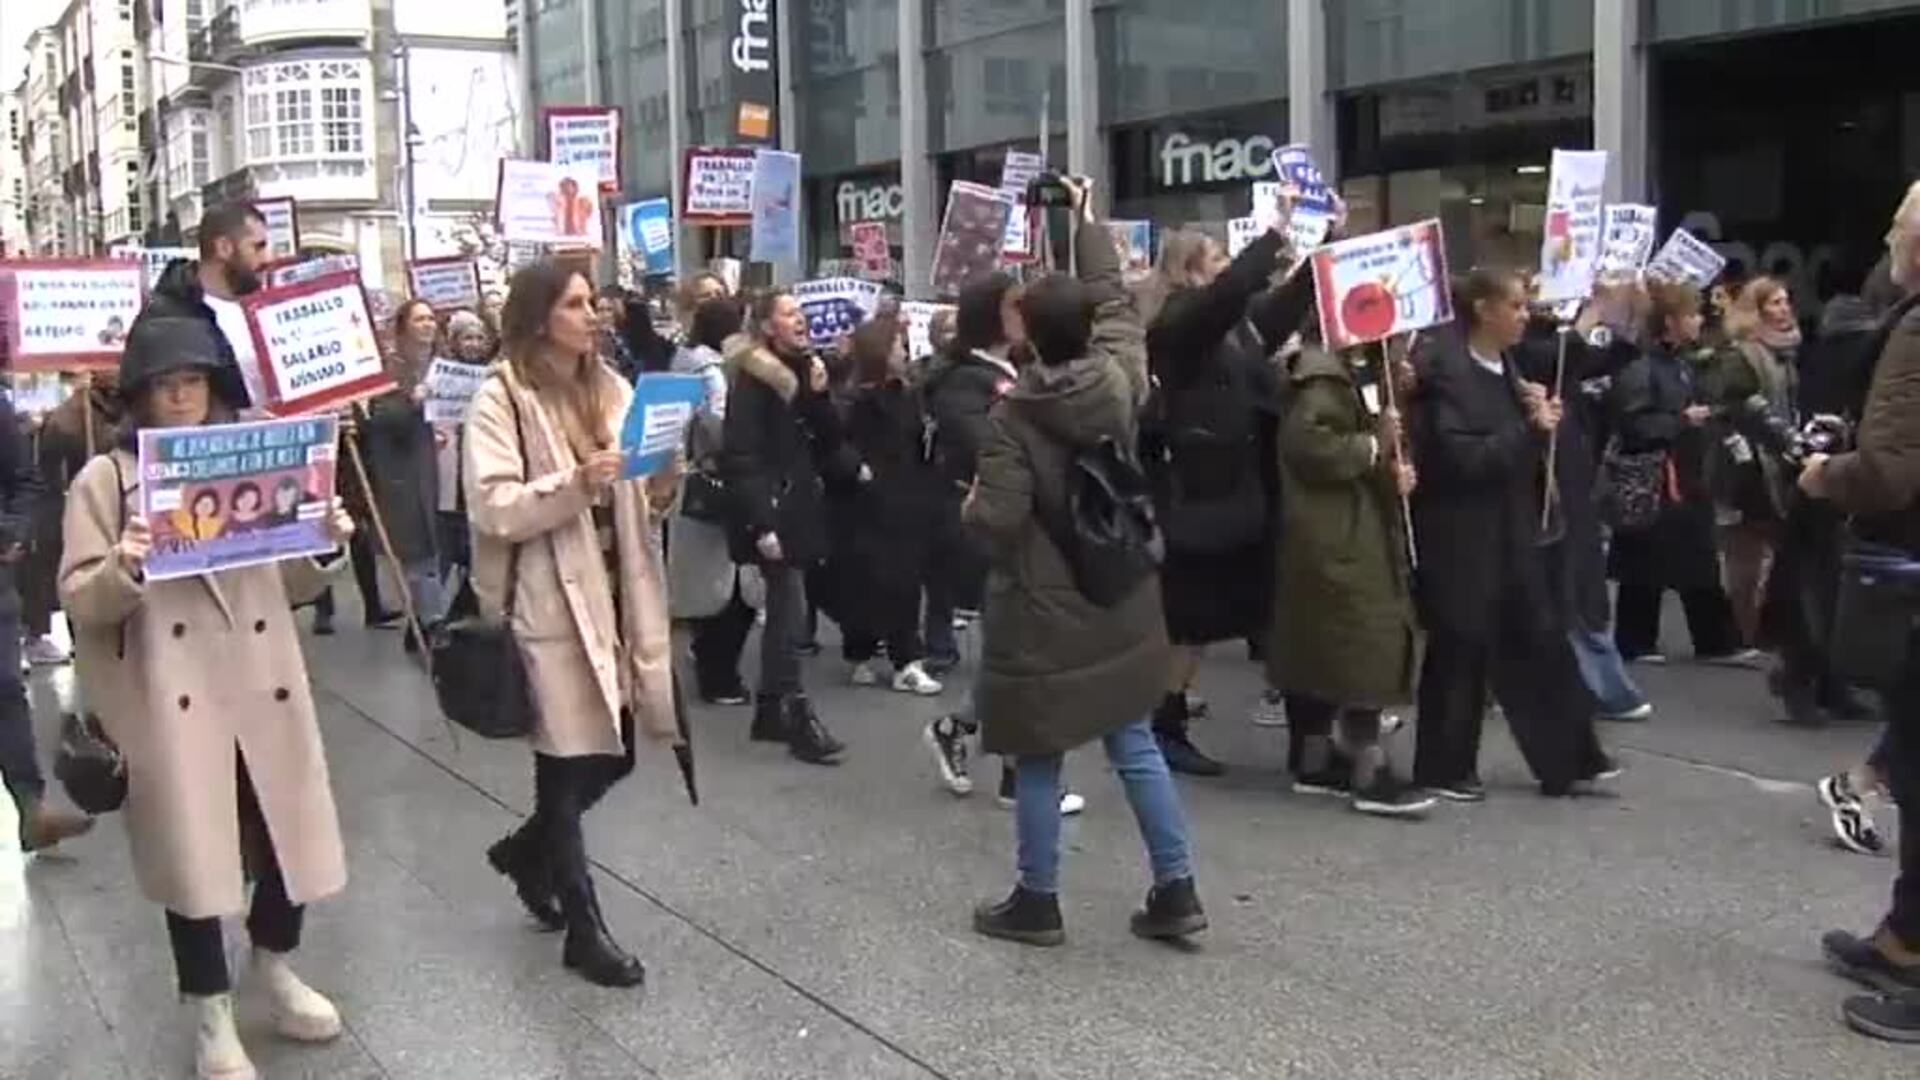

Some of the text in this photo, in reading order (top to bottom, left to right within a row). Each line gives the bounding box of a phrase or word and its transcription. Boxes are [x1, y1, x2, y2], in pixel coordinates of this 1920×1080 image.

[1160, 132, 1274, 186] fnac
[837, 181, 903, 221] fnac
[275, 296, 344, 325] TRABALLO
[281, 340, 342, 369] SALARIO
